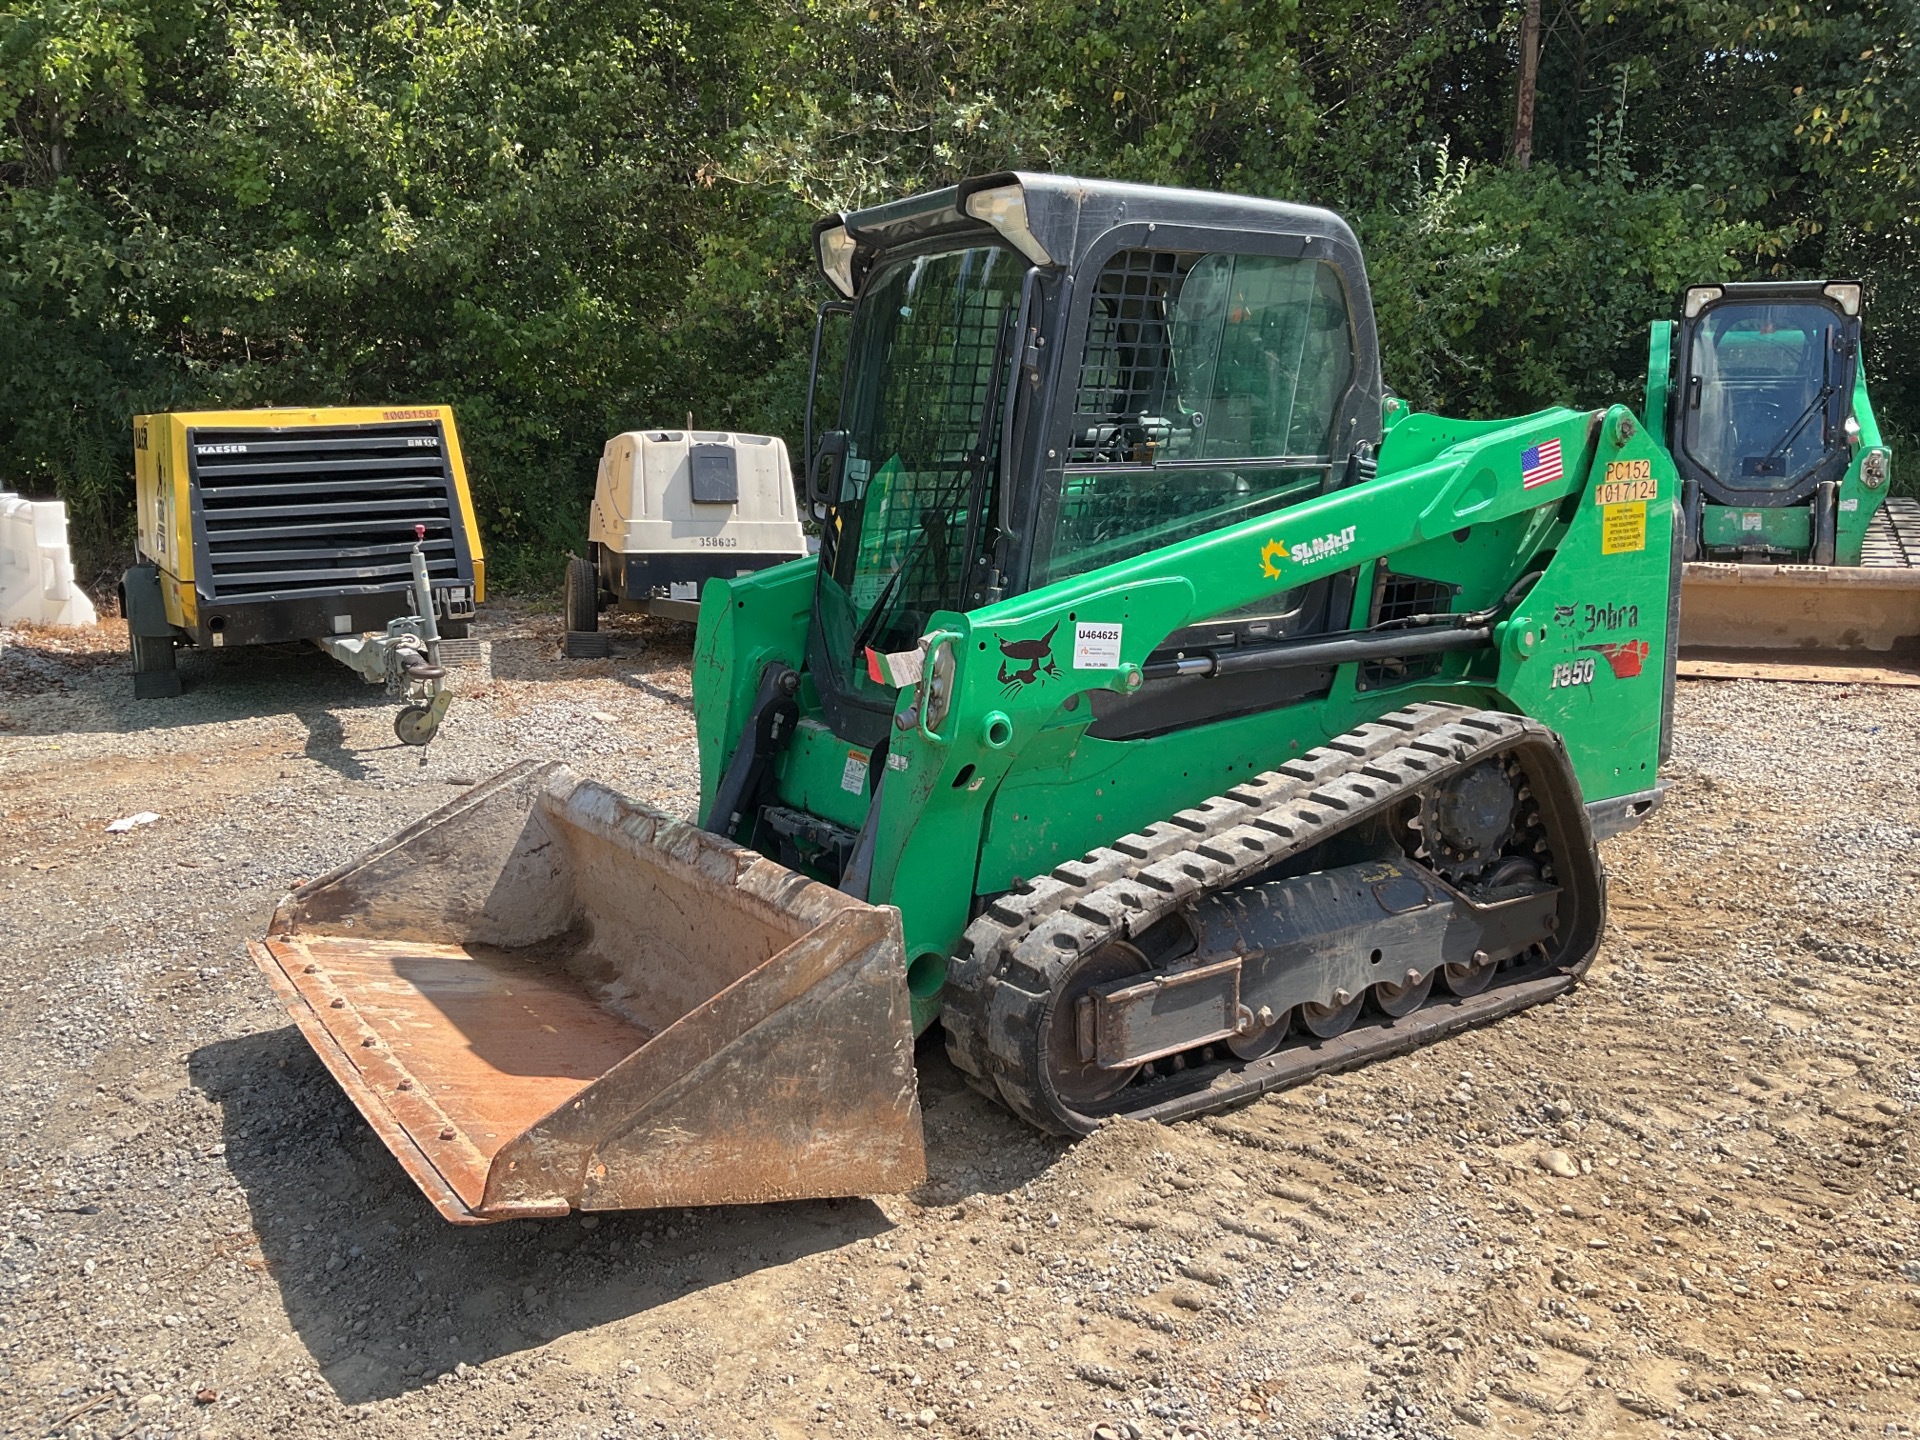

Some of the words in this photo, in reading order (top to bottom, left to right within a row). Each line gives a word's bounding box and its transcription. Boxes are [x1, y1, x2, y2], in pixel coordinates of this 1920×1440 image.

[384, 409, 439, 420] 10051587
[198, 445, 247, 454] KAESER
[1606, 460, 1650, 481] PC152
[1596, 480, 1656, 503] 1017124
[1078, 630, 1119, 640] U464625
